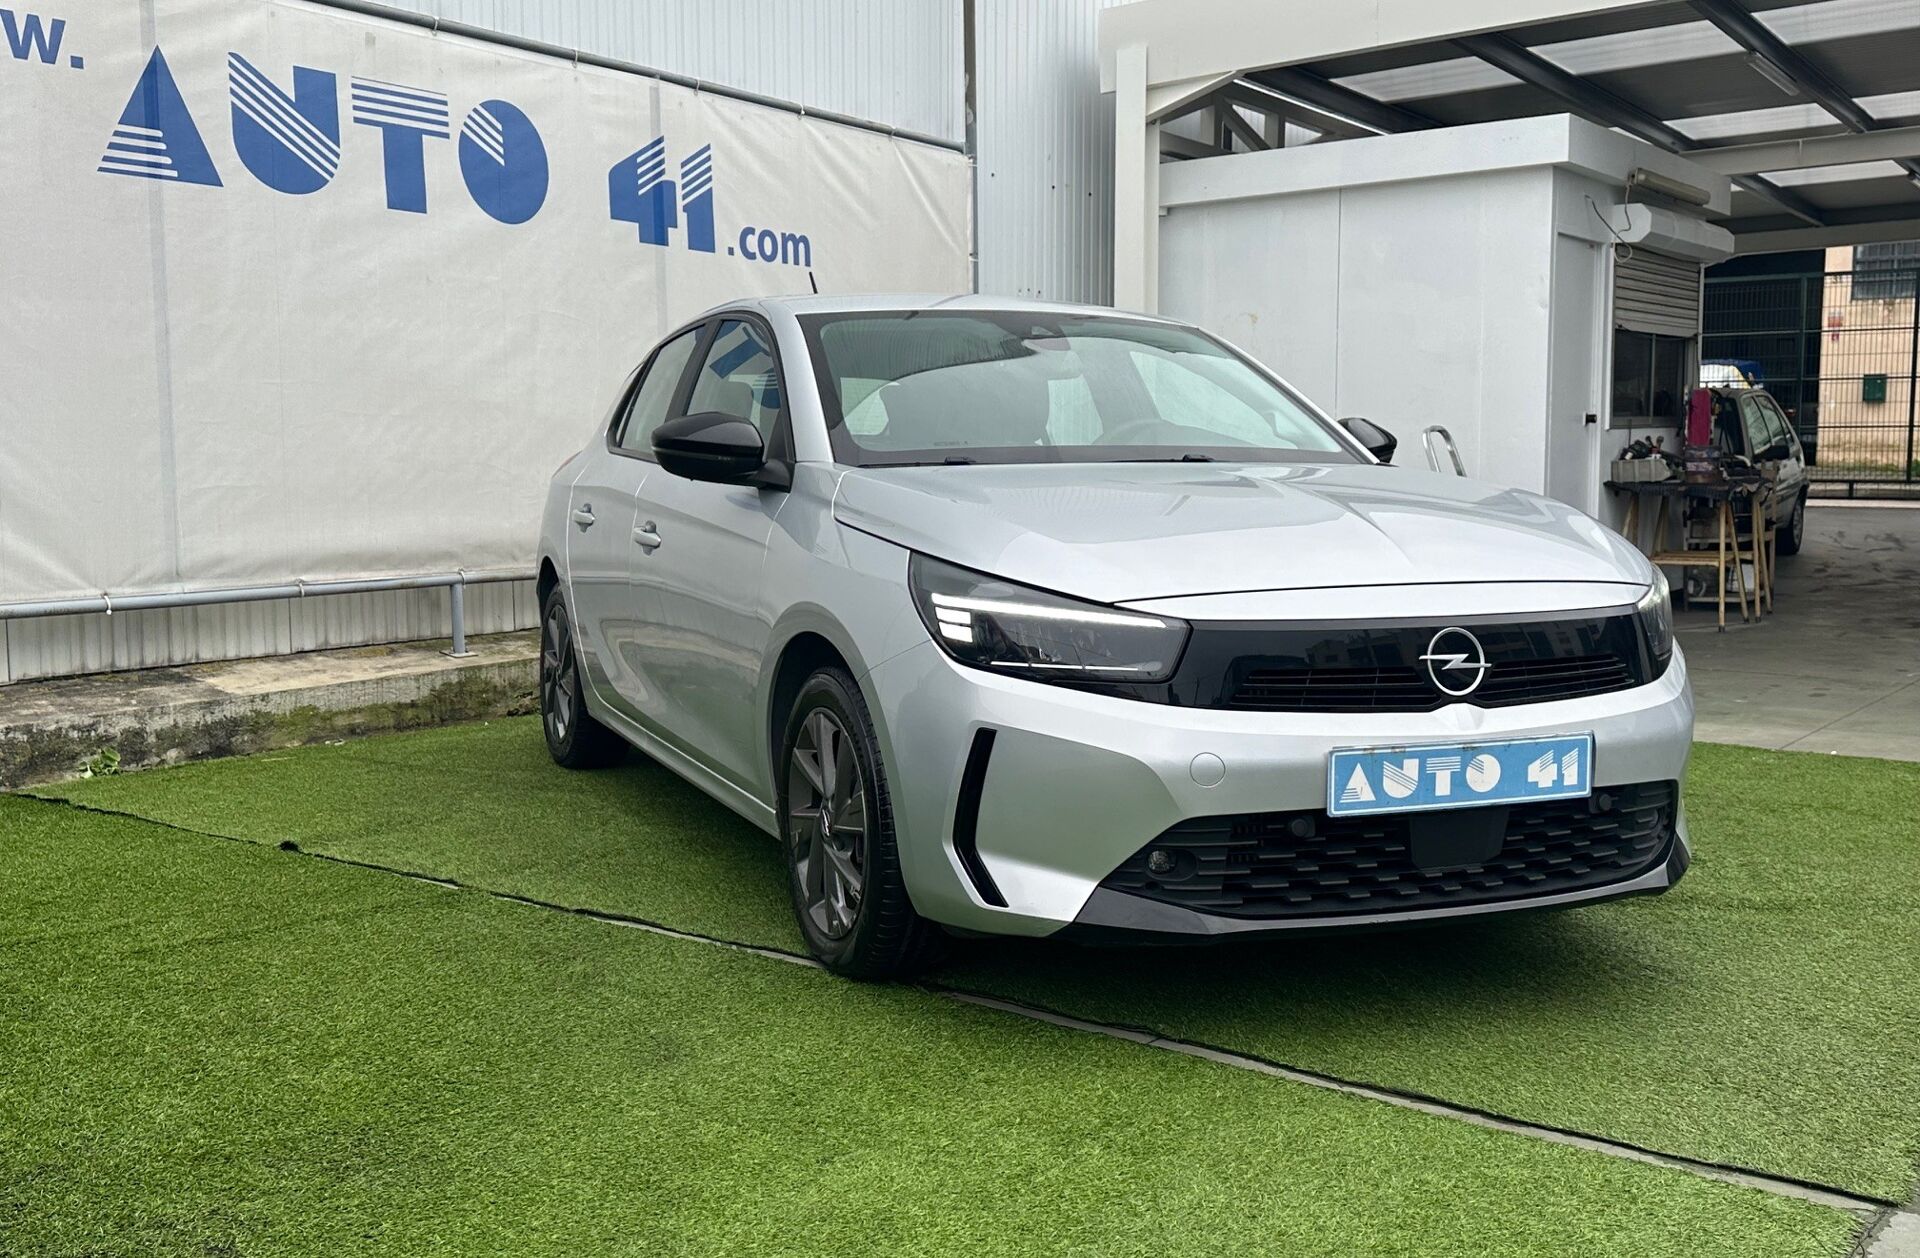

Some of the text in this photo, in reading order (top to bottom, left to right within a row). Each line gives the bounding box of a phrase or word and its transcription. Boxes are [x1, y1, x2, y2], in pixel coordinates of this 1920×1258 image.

[96, 43, 550, 225] AUTO
[607, 134, 716, 254] 41
[1339, 747, 1580, 803] AUTO 41
